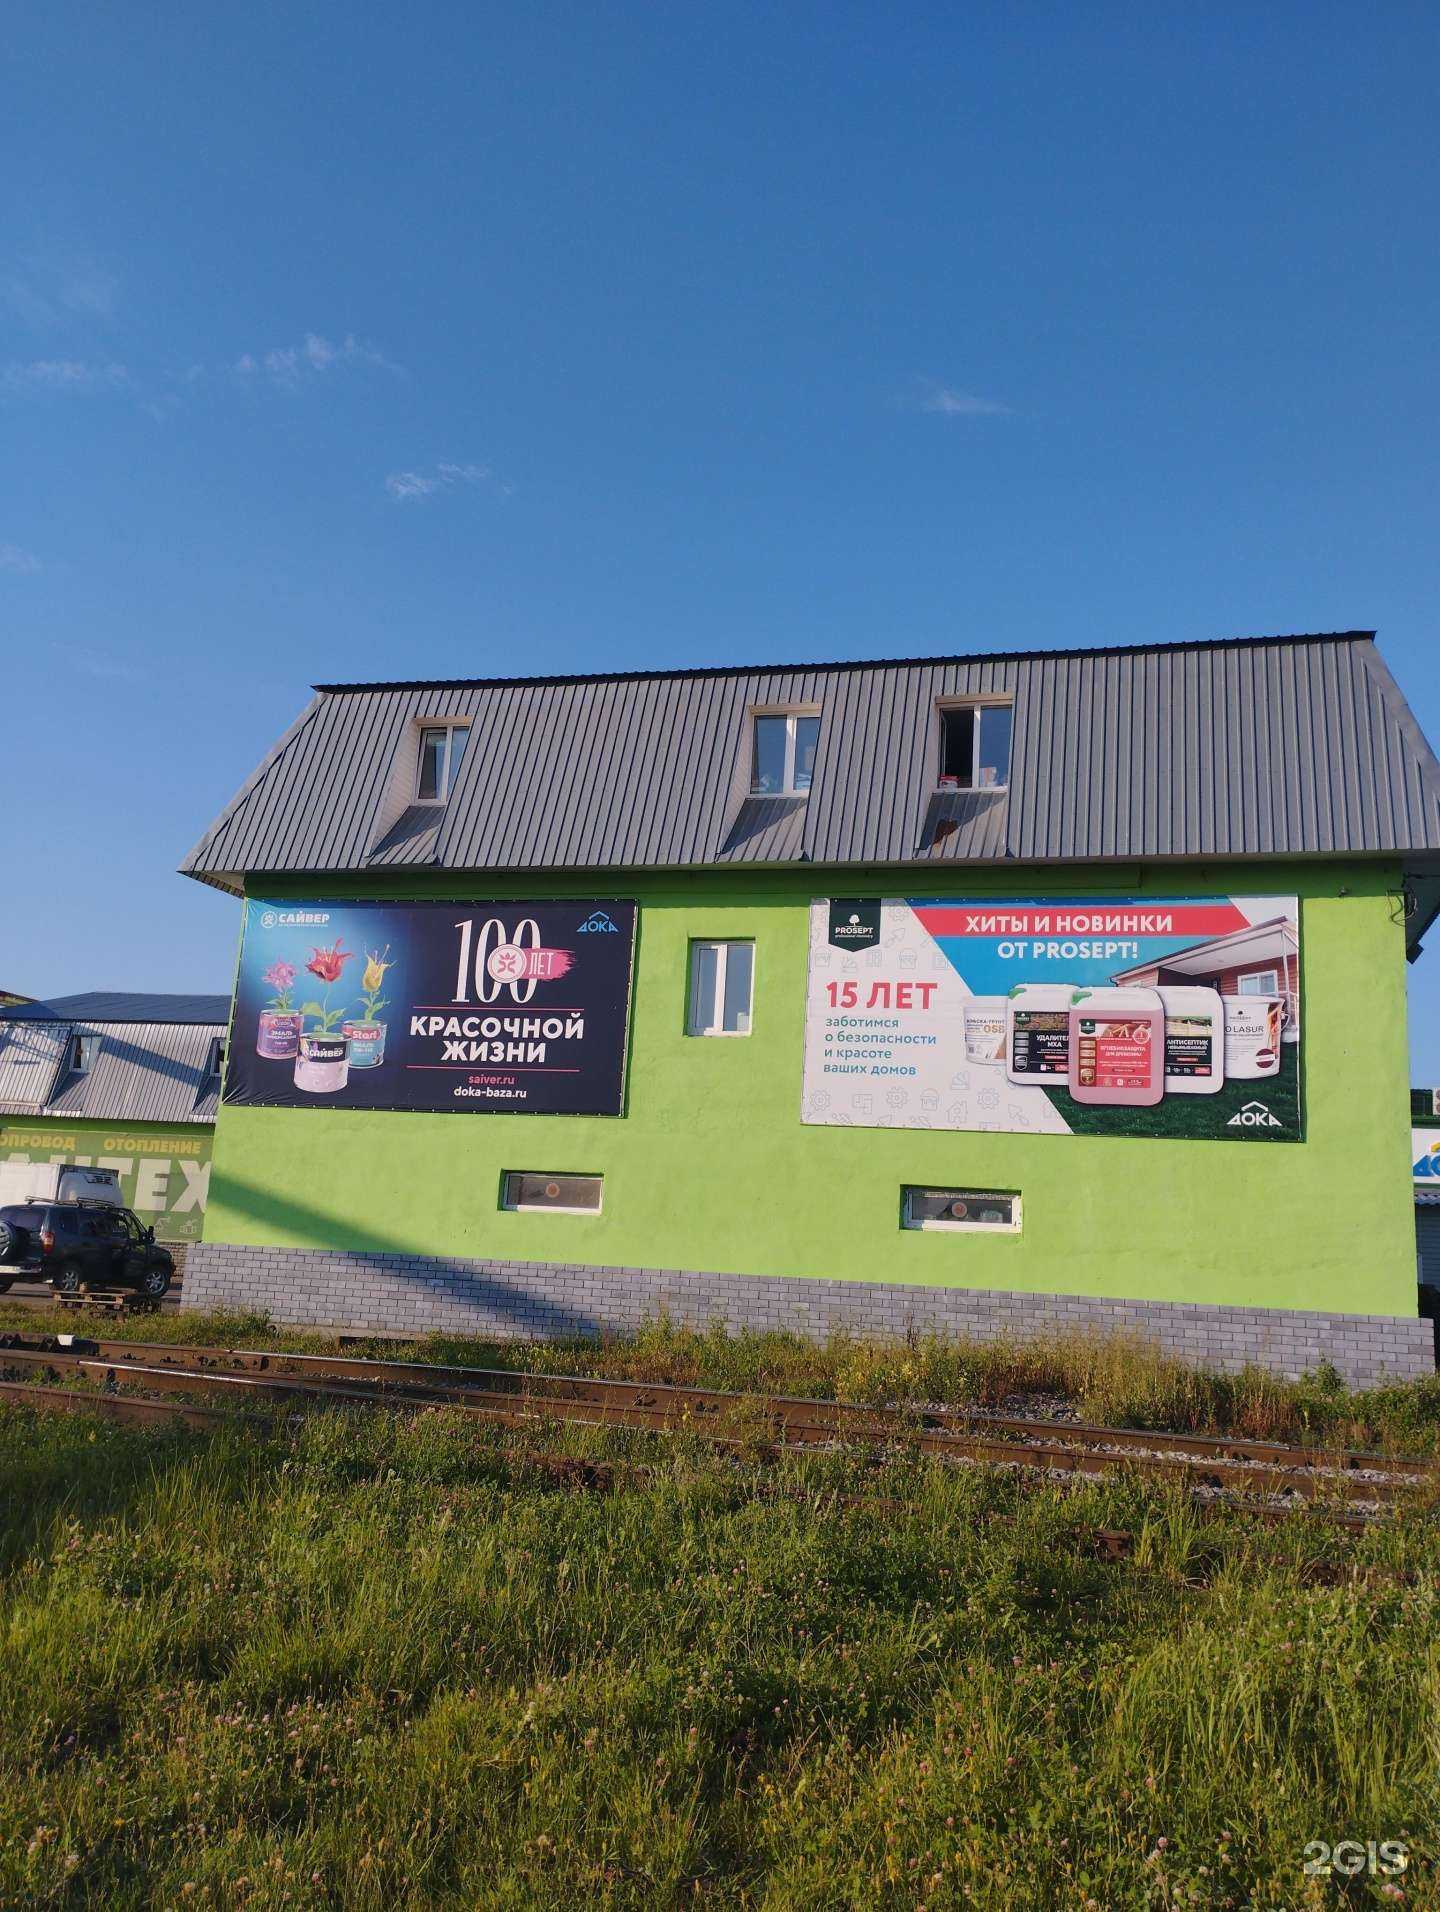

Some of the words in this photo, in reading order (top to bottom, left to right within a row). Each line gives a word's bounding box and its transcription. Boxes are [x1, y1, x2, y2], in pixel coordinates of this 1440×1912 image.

[279, 911, 330, 923] САЙВЕР
[966, 915, 1028, 932] ХИТЫ
[1034, 915, 1050, 932] И
[1056, 915, 1173, 932] НОВИНКИ
[576, 920, 619, 933] ДОКА
[997, 941, 1028, 958] ОТ
[1033, 941, 1138, 959] PROSEPT!
[452, 918, 541, 1004] 100
[528, 952, 554, 975] ЛЕТ
[826, 981, 858, 1008] 15
[866, 982, 938, 1010] ЛЕТ
[410, 1012, 585, 1040] КРАСОЧНОЙ
[825, 1016, 899, 1028] заботимся
[1233, 1025, 1264, 1033] LASUR
[352, 1030, 377, 1040] Start
[837, 1031, 937, 1045] безопасности
[440, 1040, 546, 1063] ЖИЗНИ
[824, 1049, 833, 1057] и
[836, 1049, 892, 1061] красоте
[823, 1064, 867, 1074] ваших
[871, 1066, 916, 1076] домов
[468, 1073, 515, 1085] saiver.ru
[453, 1085, 527, 1099] doka-baza.ru
[1226, 1111, 1283, 1127] ДОКА
[104, 1137, 201, 1154] ОТОПЛЕНИЕ
